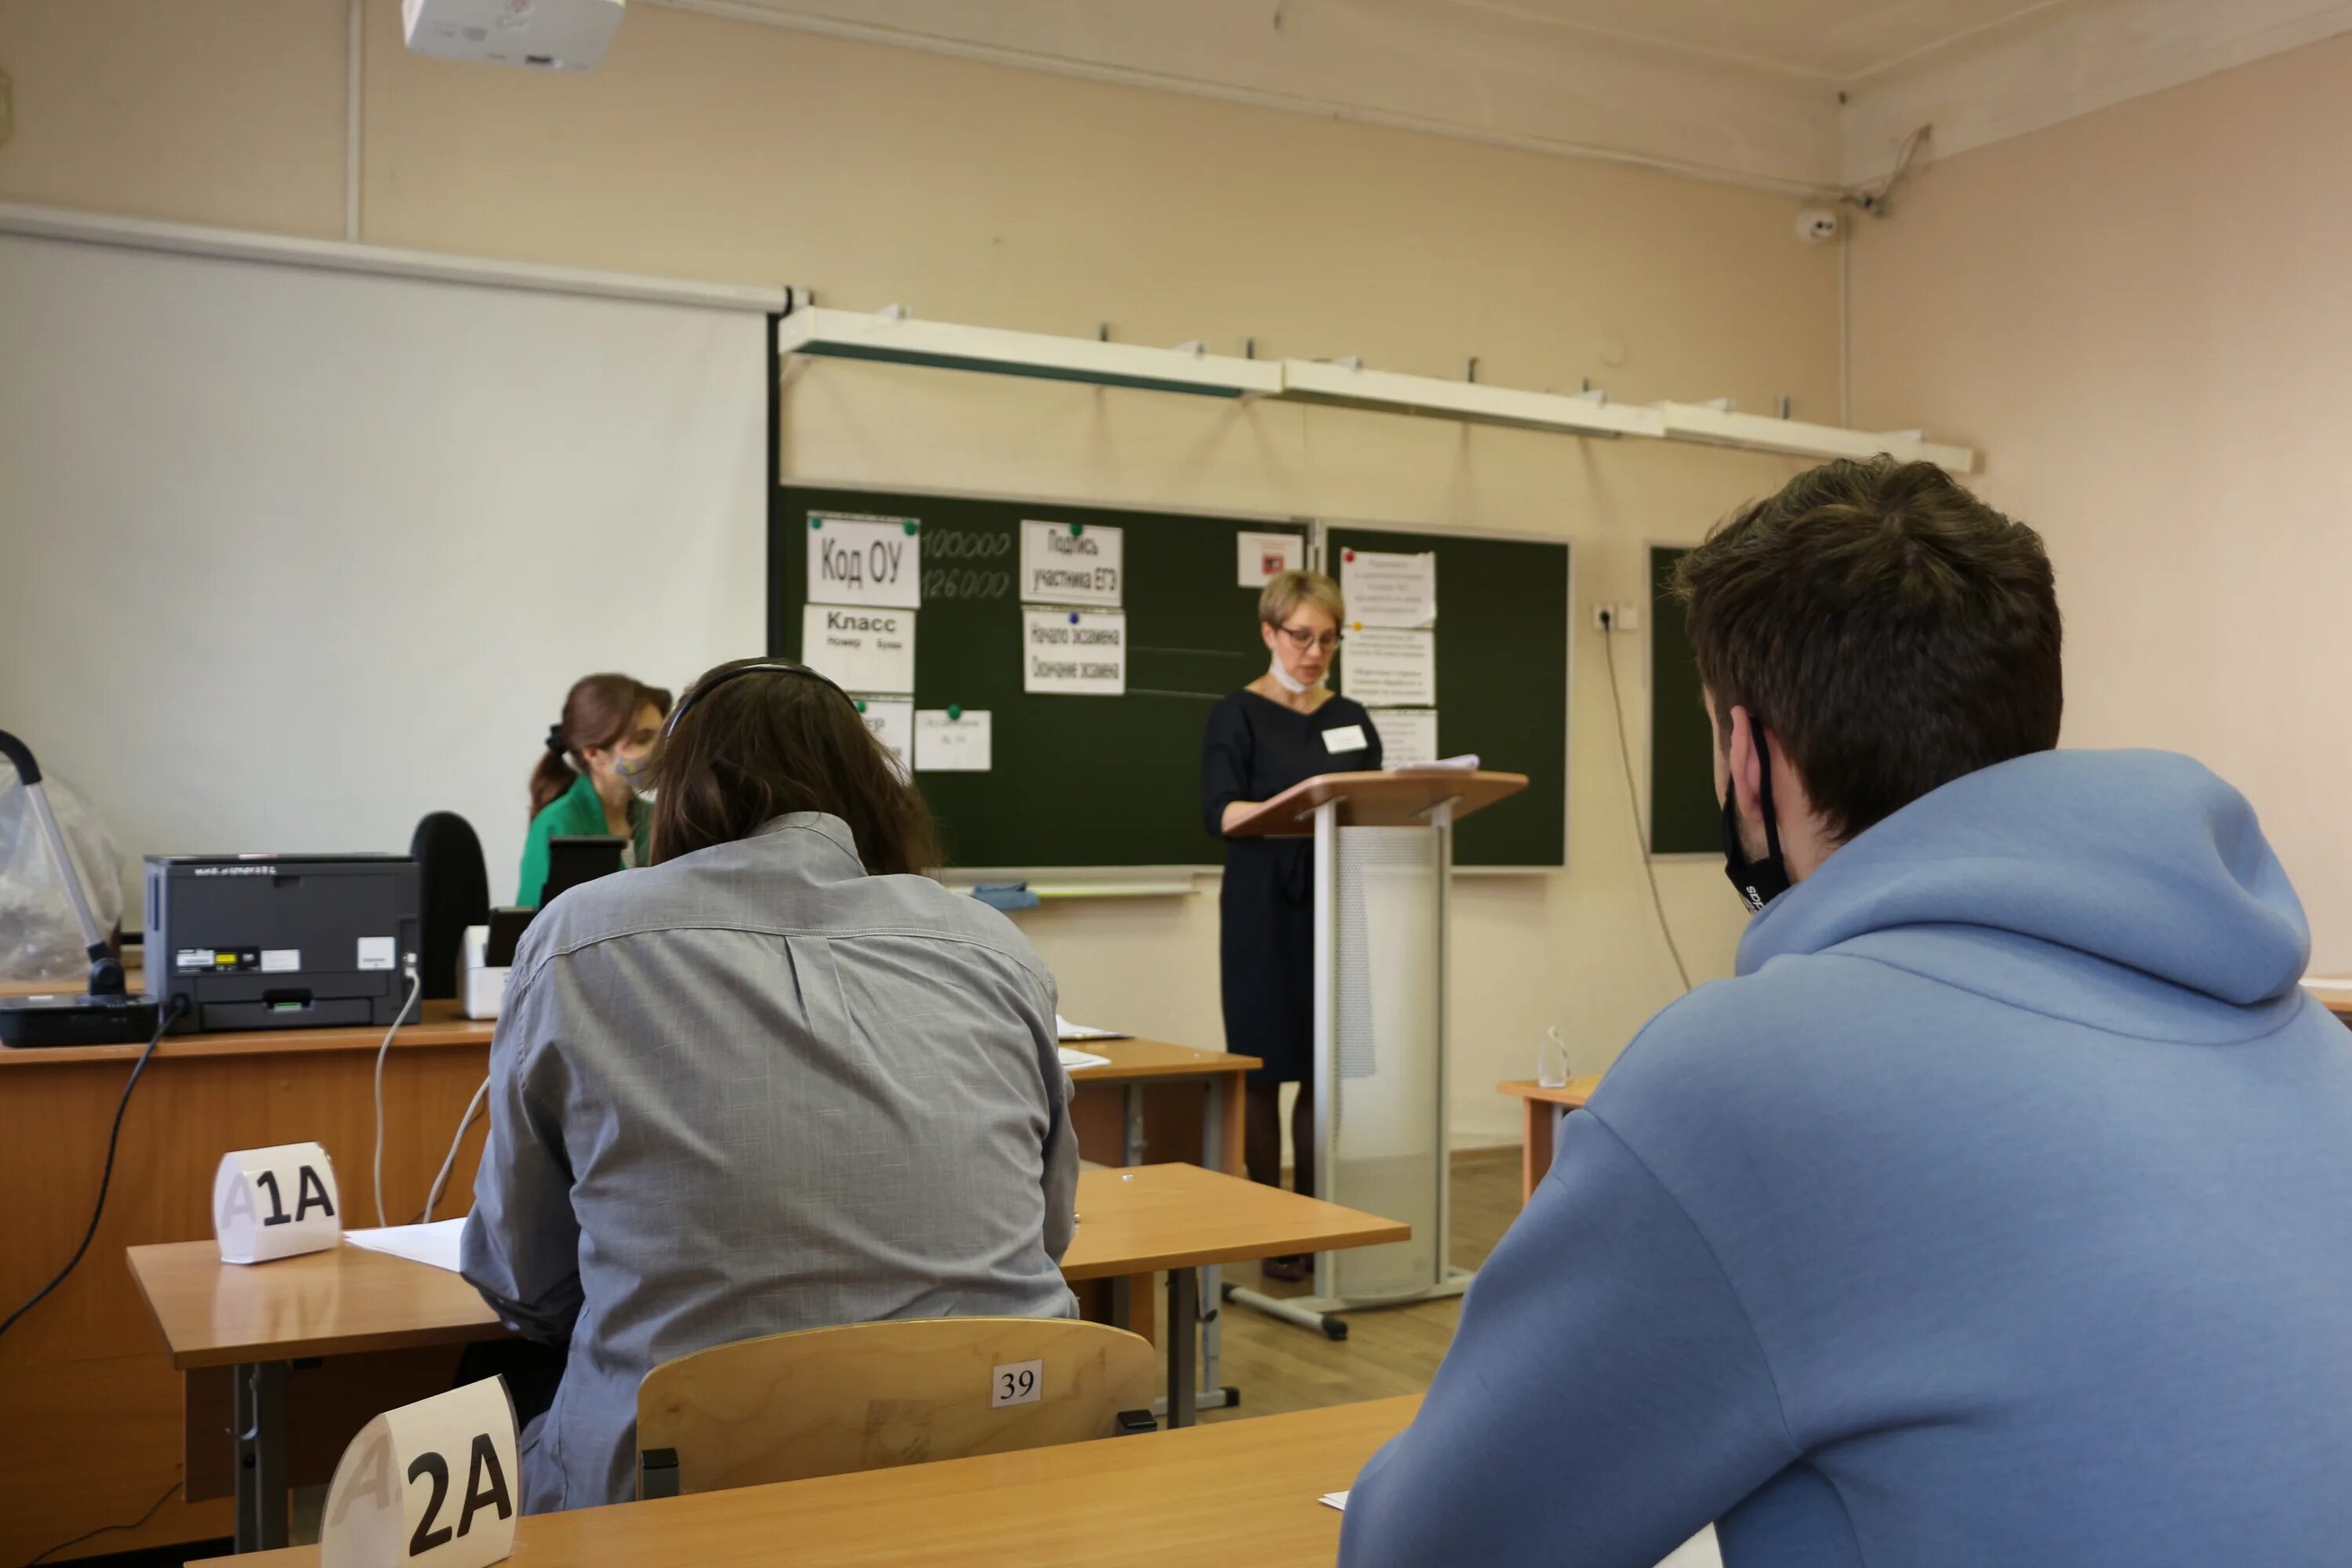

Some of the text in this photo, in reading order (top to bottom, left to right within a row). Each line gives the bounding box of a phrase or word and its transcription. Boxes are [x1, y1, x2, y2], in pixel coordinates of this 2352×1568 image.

[921, 528, 1011, 558] 100000
[822, 537, 903, 589] Код ОУ
[922, 568, 1011, 599] 126000
[827, 611, 897, 633] Класс
[1000, 1370, 1034, 1400] 39
